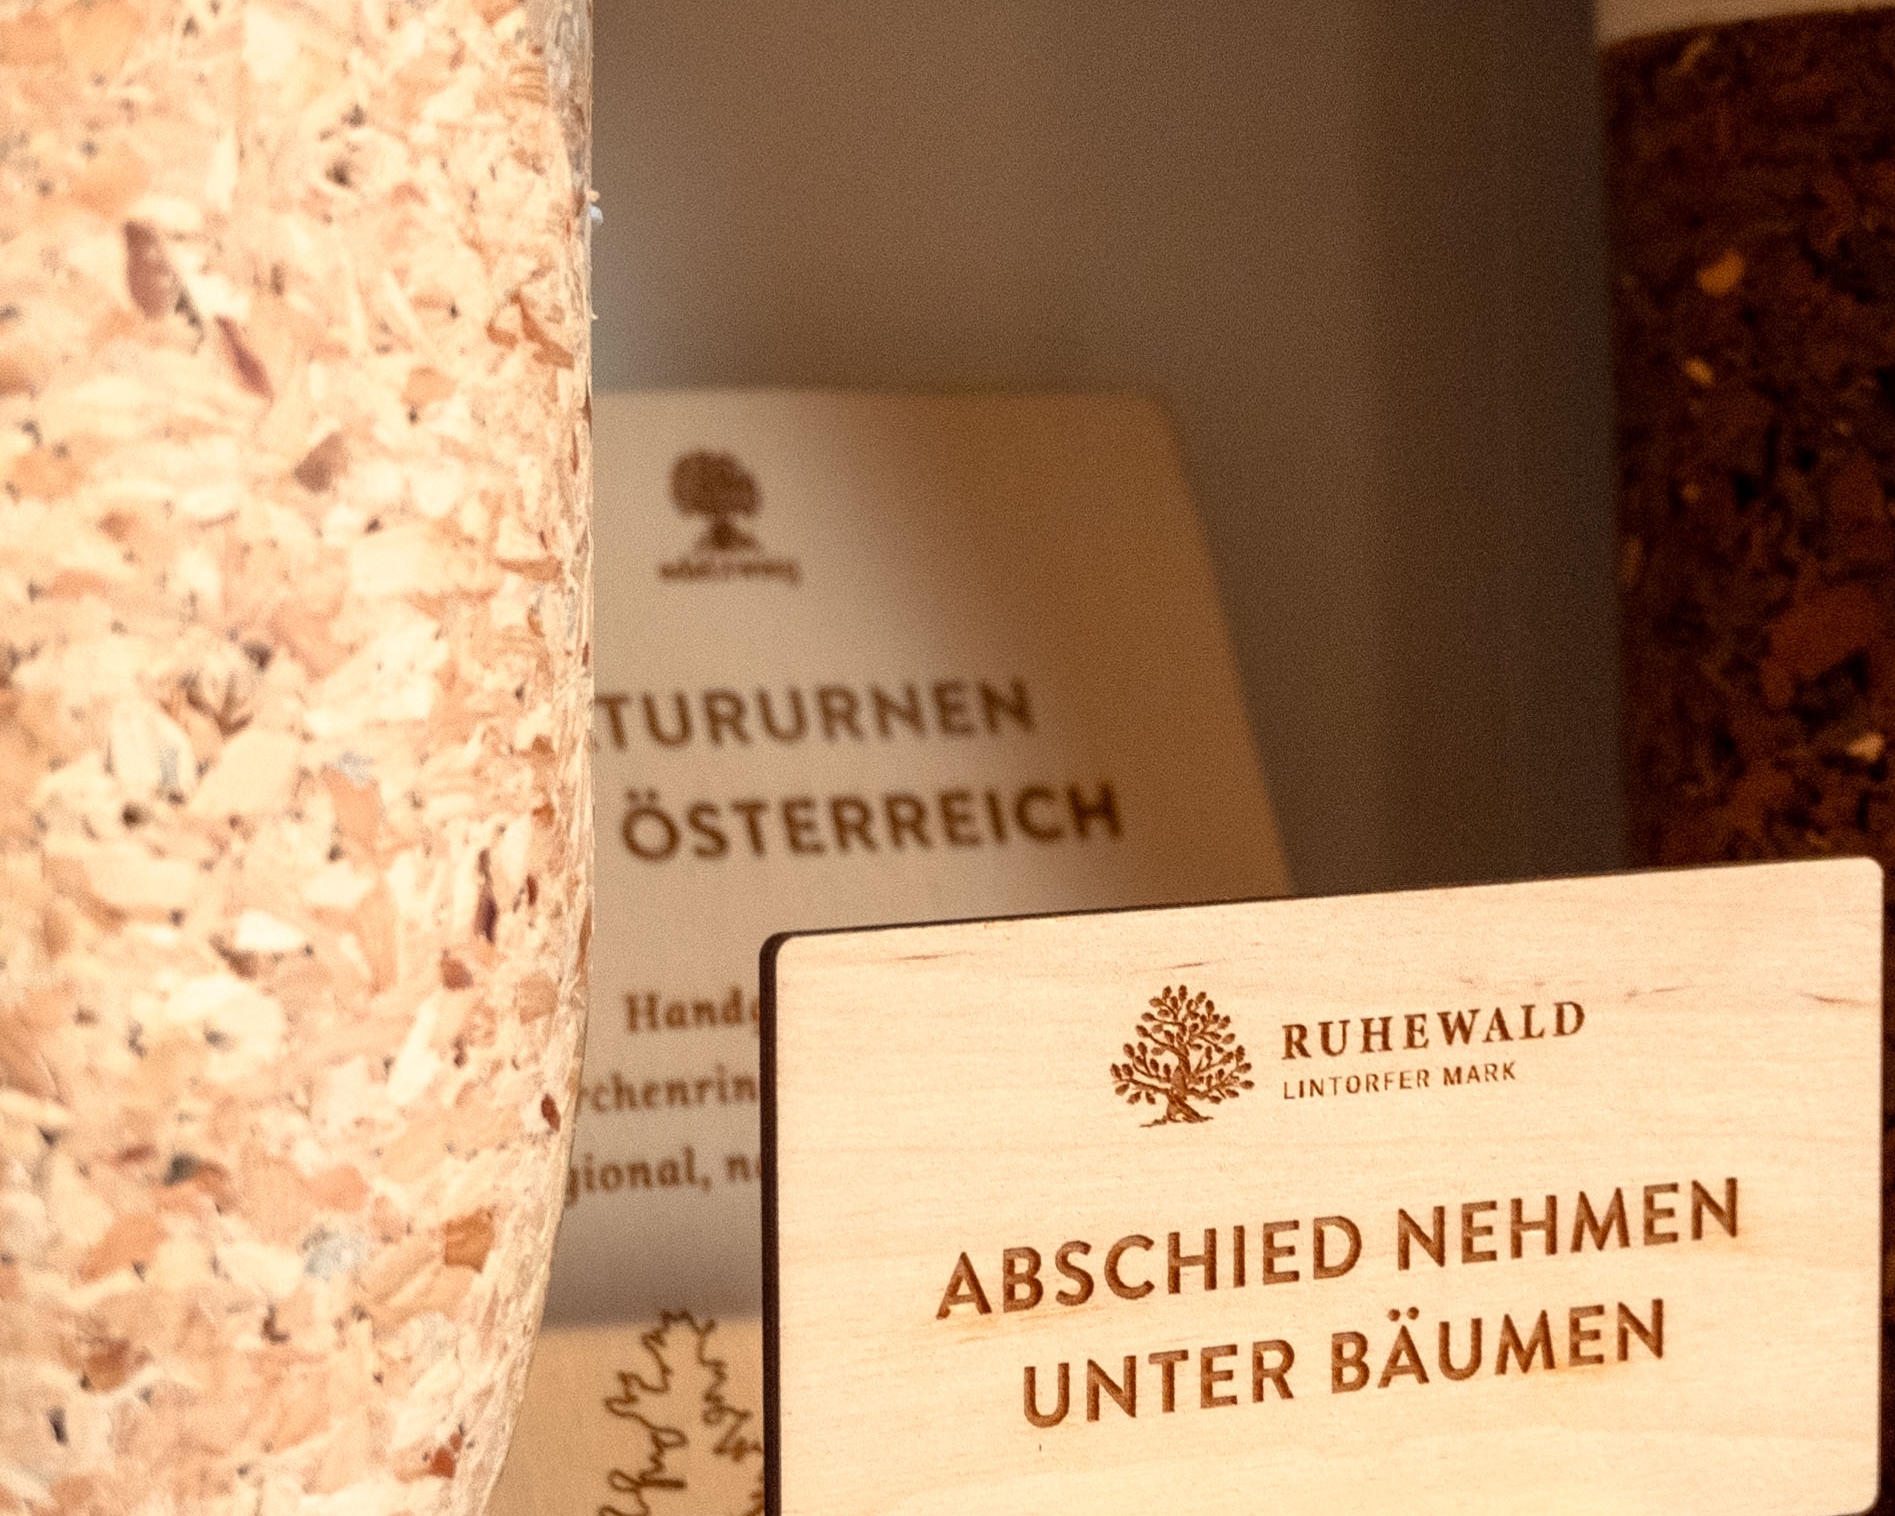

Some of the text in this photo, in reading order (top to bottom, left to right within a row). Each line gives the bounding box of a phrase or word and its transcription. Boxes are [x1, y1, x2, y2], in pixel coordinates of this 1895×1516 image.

[588, 676, 1036, 753] TURURNEN
[621, 784, 1124, 863] ÖSTERREICH
[1282, 998, 1588, 1063] RUHEWALD
[1282, 1060, 1518, 1102] LINTORFER MARK
[934, 1175, 1740, 1321] ABSCHIED NEHMEN
[1023, 1295, 1668, 1429] UNTER BÄUMEN
